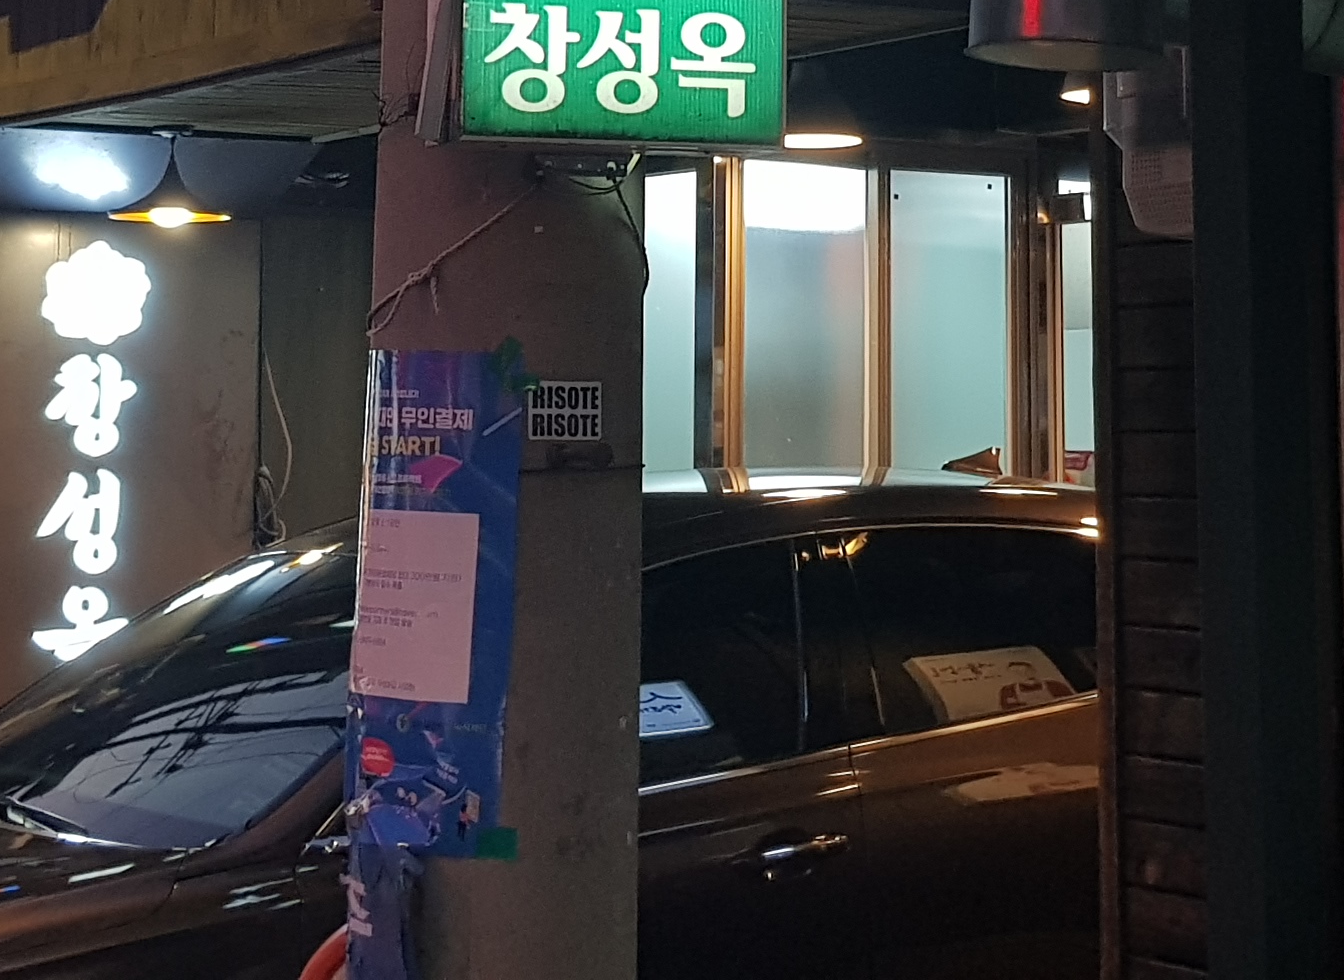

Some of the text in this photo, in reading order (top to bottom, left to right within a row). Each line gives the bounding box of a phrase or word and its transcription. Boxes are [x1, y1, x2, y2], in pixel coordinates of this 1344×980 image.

[484, 1, 756, 118] 창성옥
[532, 386, 599, 409] RISOTE
[401, 407, 474, 431] 무인결제
[532, 413, 599, 437] RISOTE
